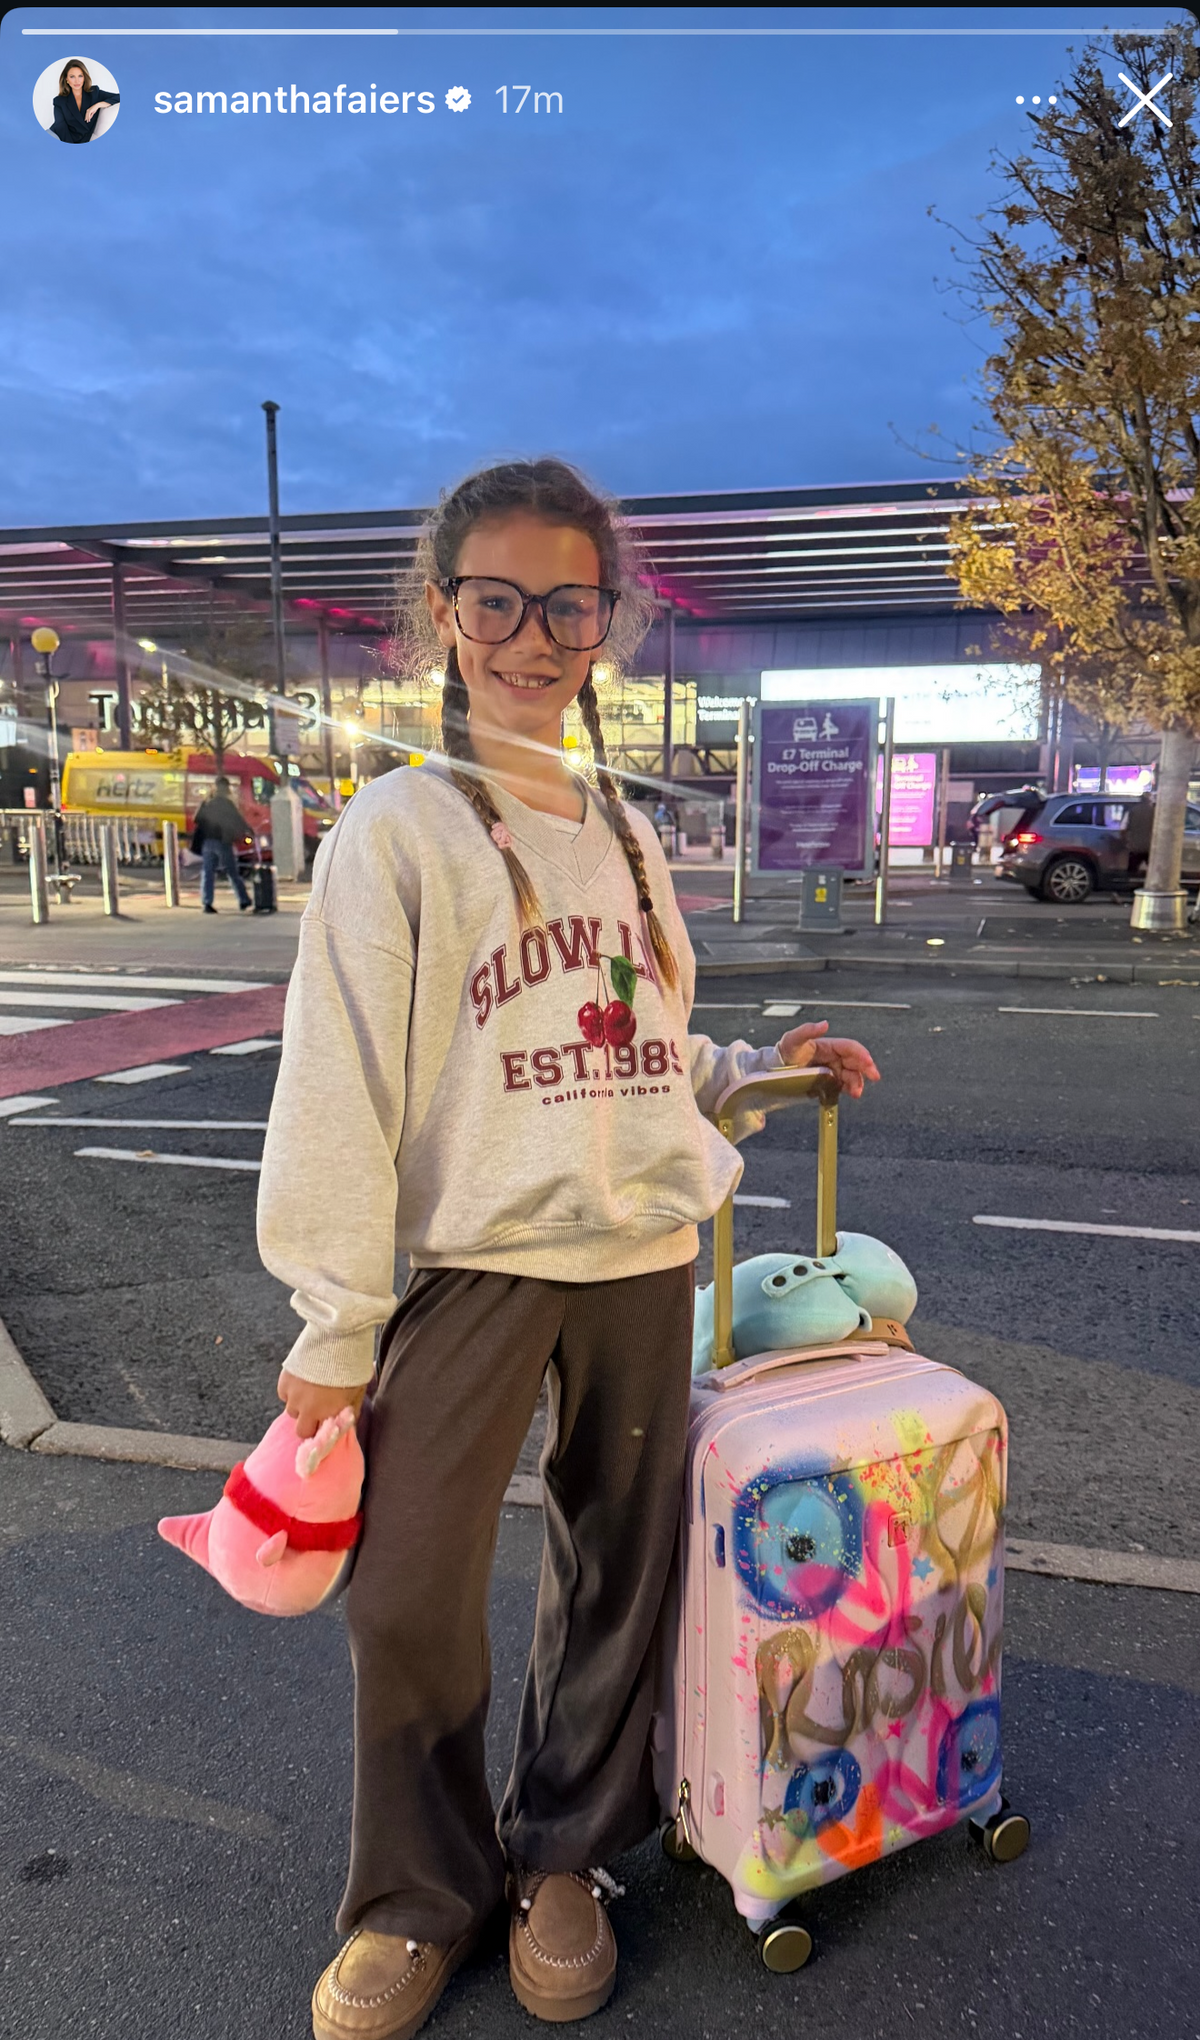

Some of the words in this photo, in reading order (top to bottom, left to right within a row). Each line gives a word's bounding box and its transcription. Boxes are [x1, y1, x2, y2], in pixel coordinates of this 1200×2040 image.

[781, 748, 797, 761] £7
[799, 746, 850, 760] Terminal
[767, 761, 820, 775] Drop-Off
[821, 759, 864, 773] Charge
[469, 914, 603, 1031] SLOW
[616, 918, 659, 986] L
[541, 1086, 614, 1106] california
[620, 1084, 671, 1097] vibes
